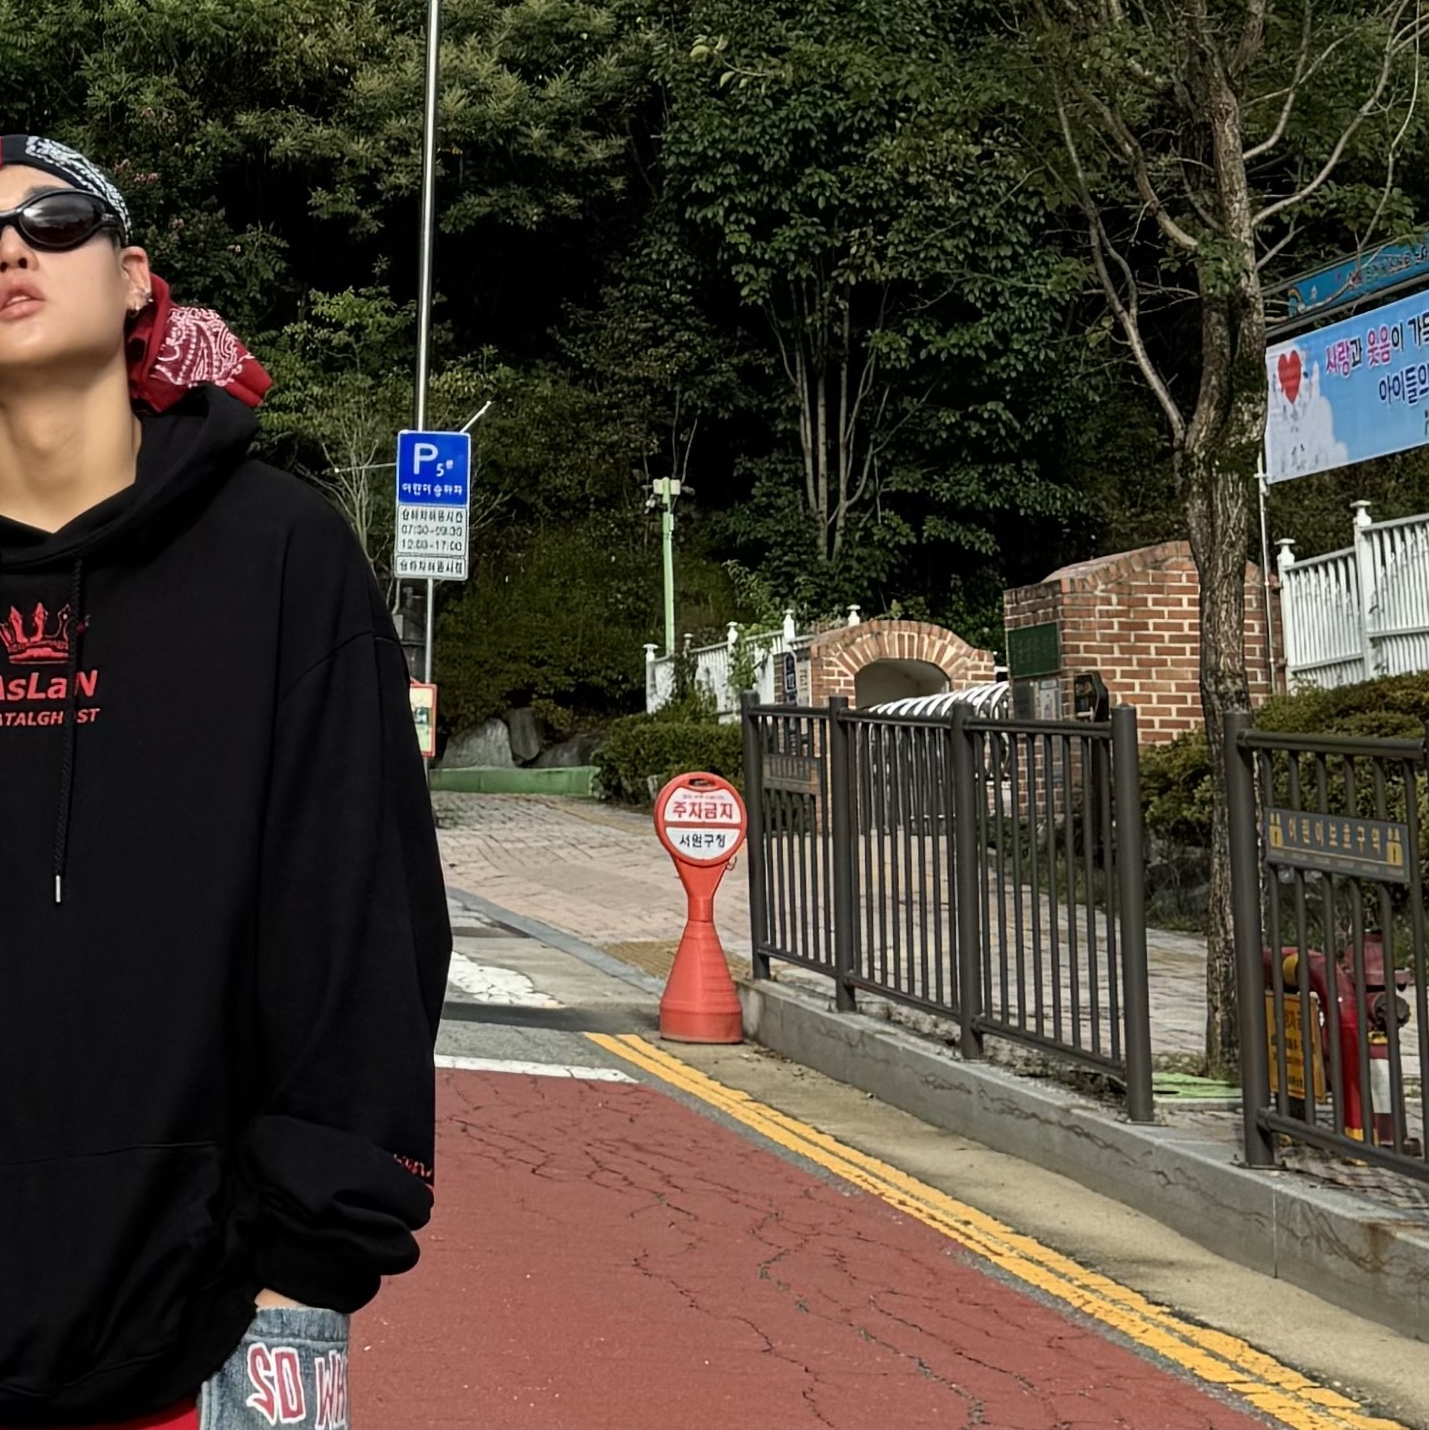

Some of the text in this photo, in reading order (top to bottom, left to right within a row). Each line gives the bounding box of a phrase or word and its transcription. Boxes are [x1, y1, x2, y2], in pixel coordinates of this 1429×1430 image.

[1325, 336, 1363, 376] 사랑과
[1367, 322, 1404, 366] 웃음이
[413, 442, 439, 475] P
[672, 801, 733, 820] 주차금지
[679, 833, 726, 849] 서원구청
[1287, 815, 1382, 855] 어린이보호구역
[246, 1341, 307, 1426] SO
